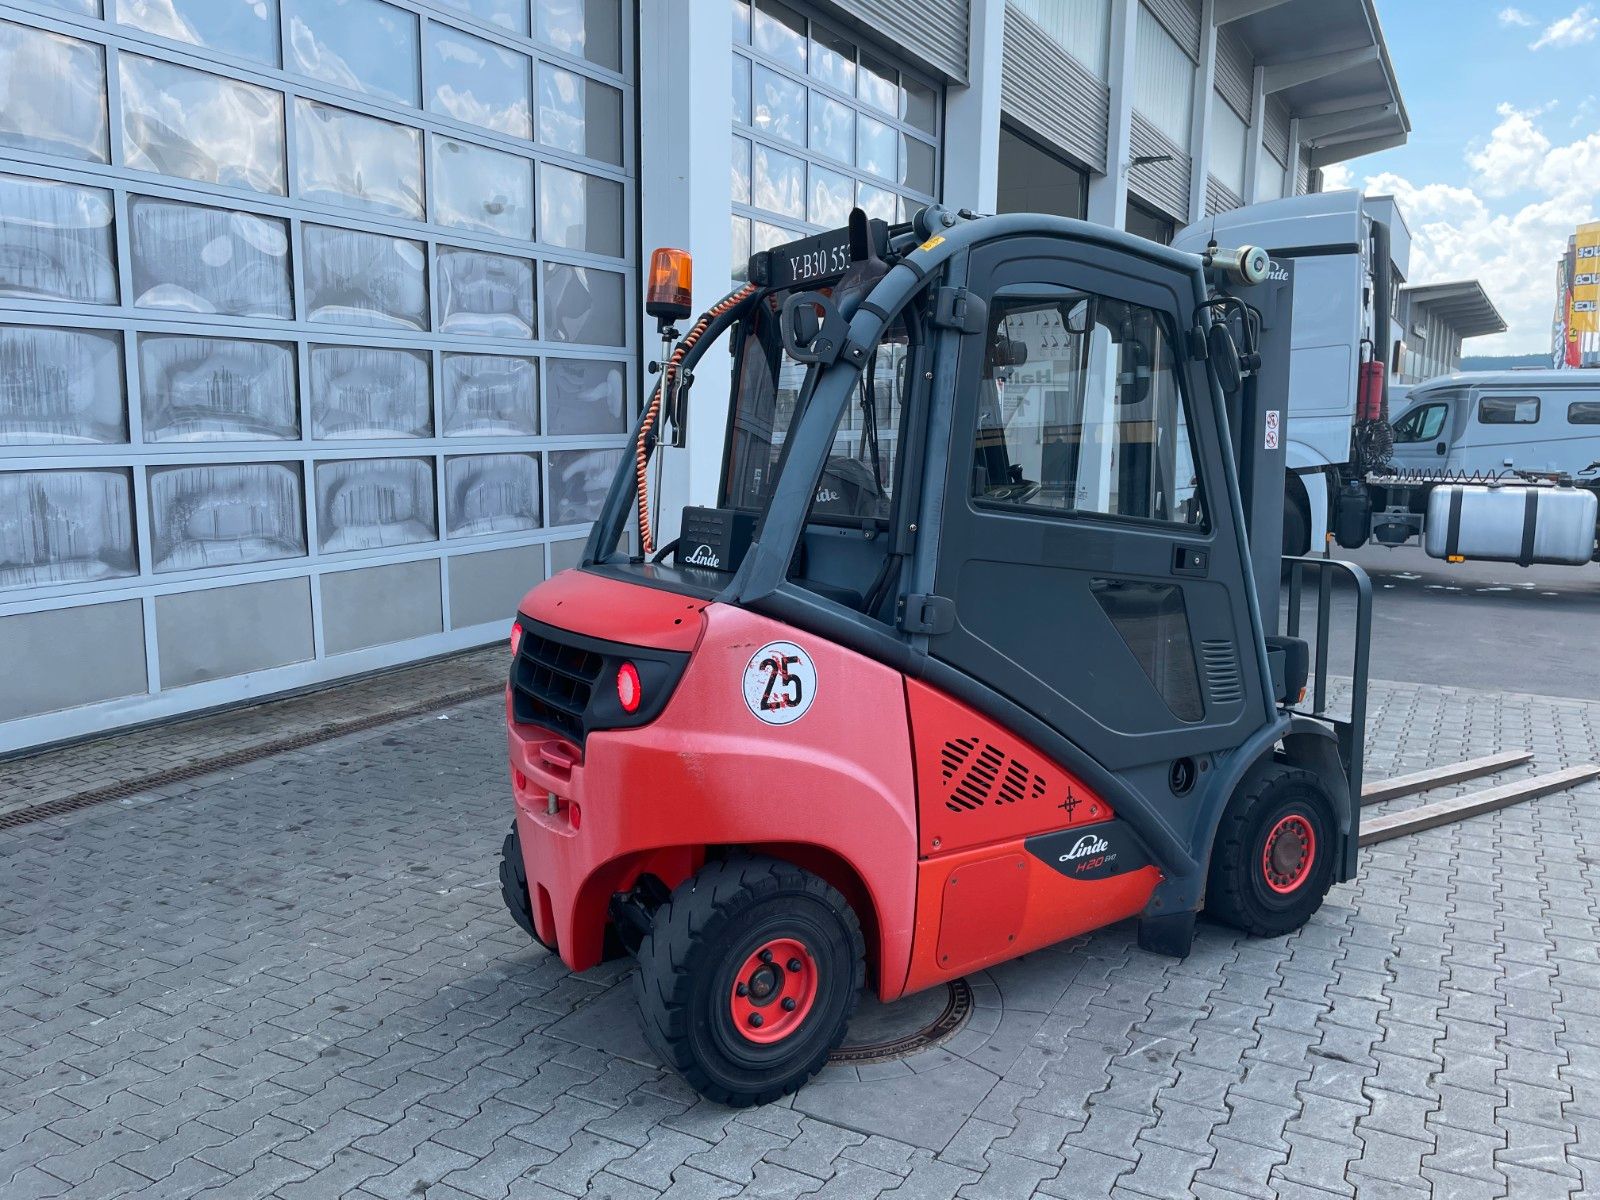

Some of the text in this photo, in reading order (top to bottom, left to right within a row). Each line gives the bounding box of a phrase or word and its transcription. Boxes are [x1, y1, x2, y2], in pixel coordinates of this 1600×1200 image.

[790, 249, 827, 280] Y-B30
[1265, 260, 1289, 281] nde
[685, 544, 720, 568] Linde
[758, 655, 803, 711] 25
[1059, 834, 1109, 862] Linde
[1075, 856, 1105, 874] H20
